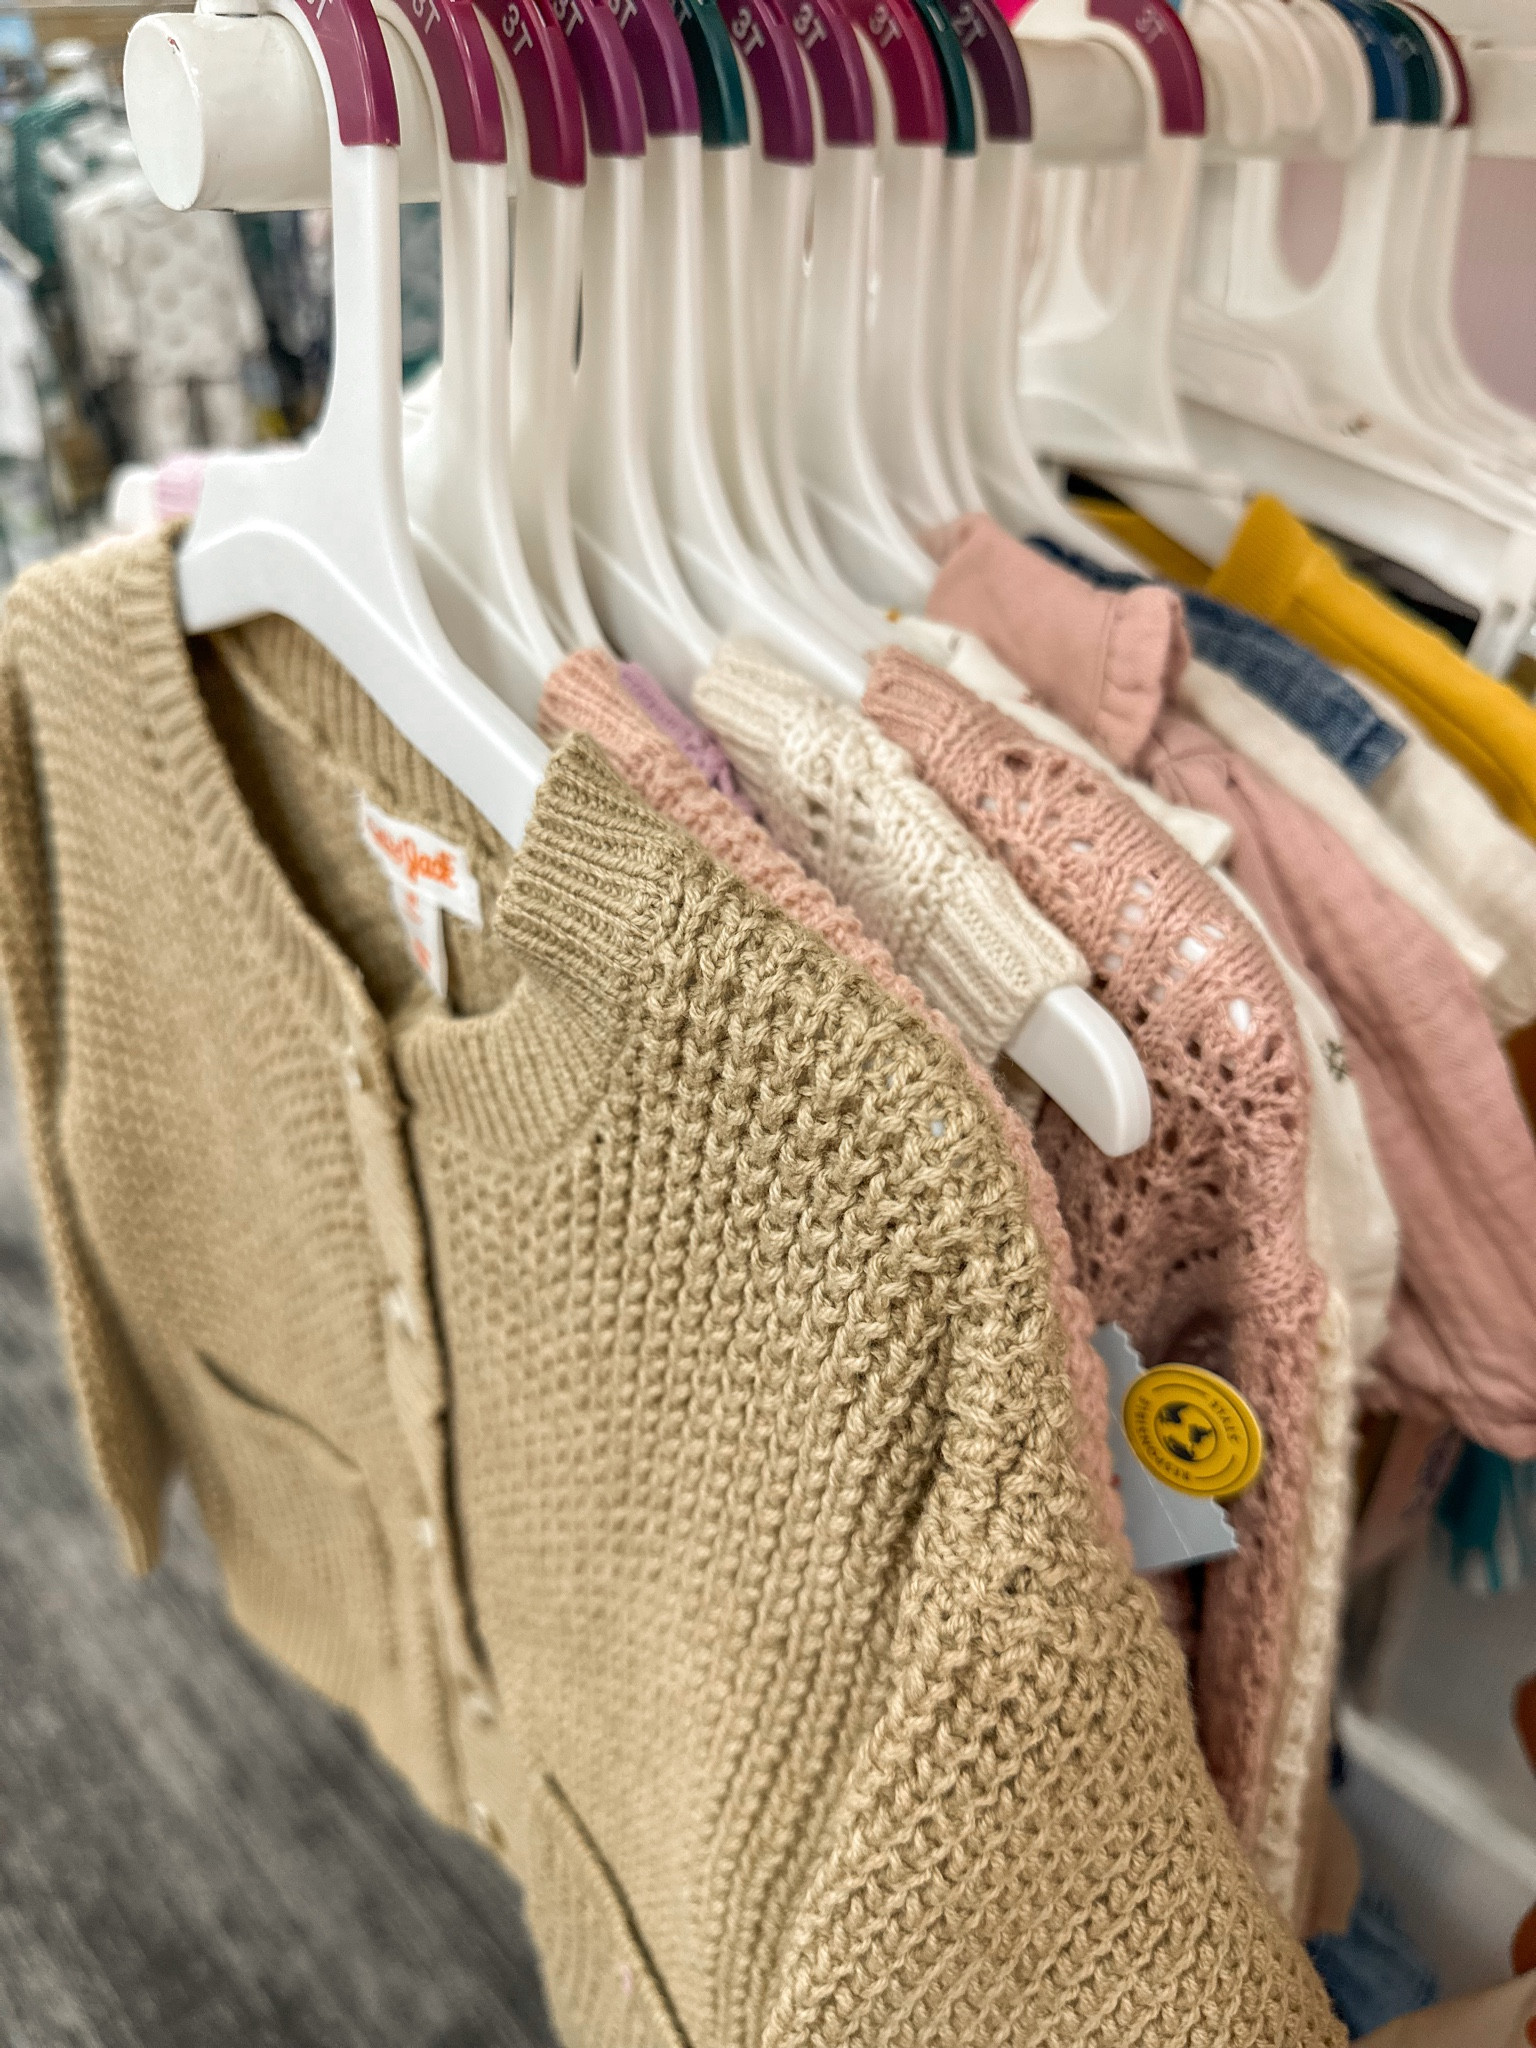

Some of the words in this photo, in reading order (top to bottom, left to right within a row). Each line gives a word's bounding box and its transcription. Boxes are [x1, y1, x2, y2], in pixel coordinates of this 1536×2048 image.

[502, 3, 533, 56] 3T
[731, 6, 765, 56] 3T
[793, 2, 827, 50] 3T
[868, 3, 902, 48] 3T
[952, 3, 986, 48] 2T
[1209, 1399, 1240, 1444] STYLE
